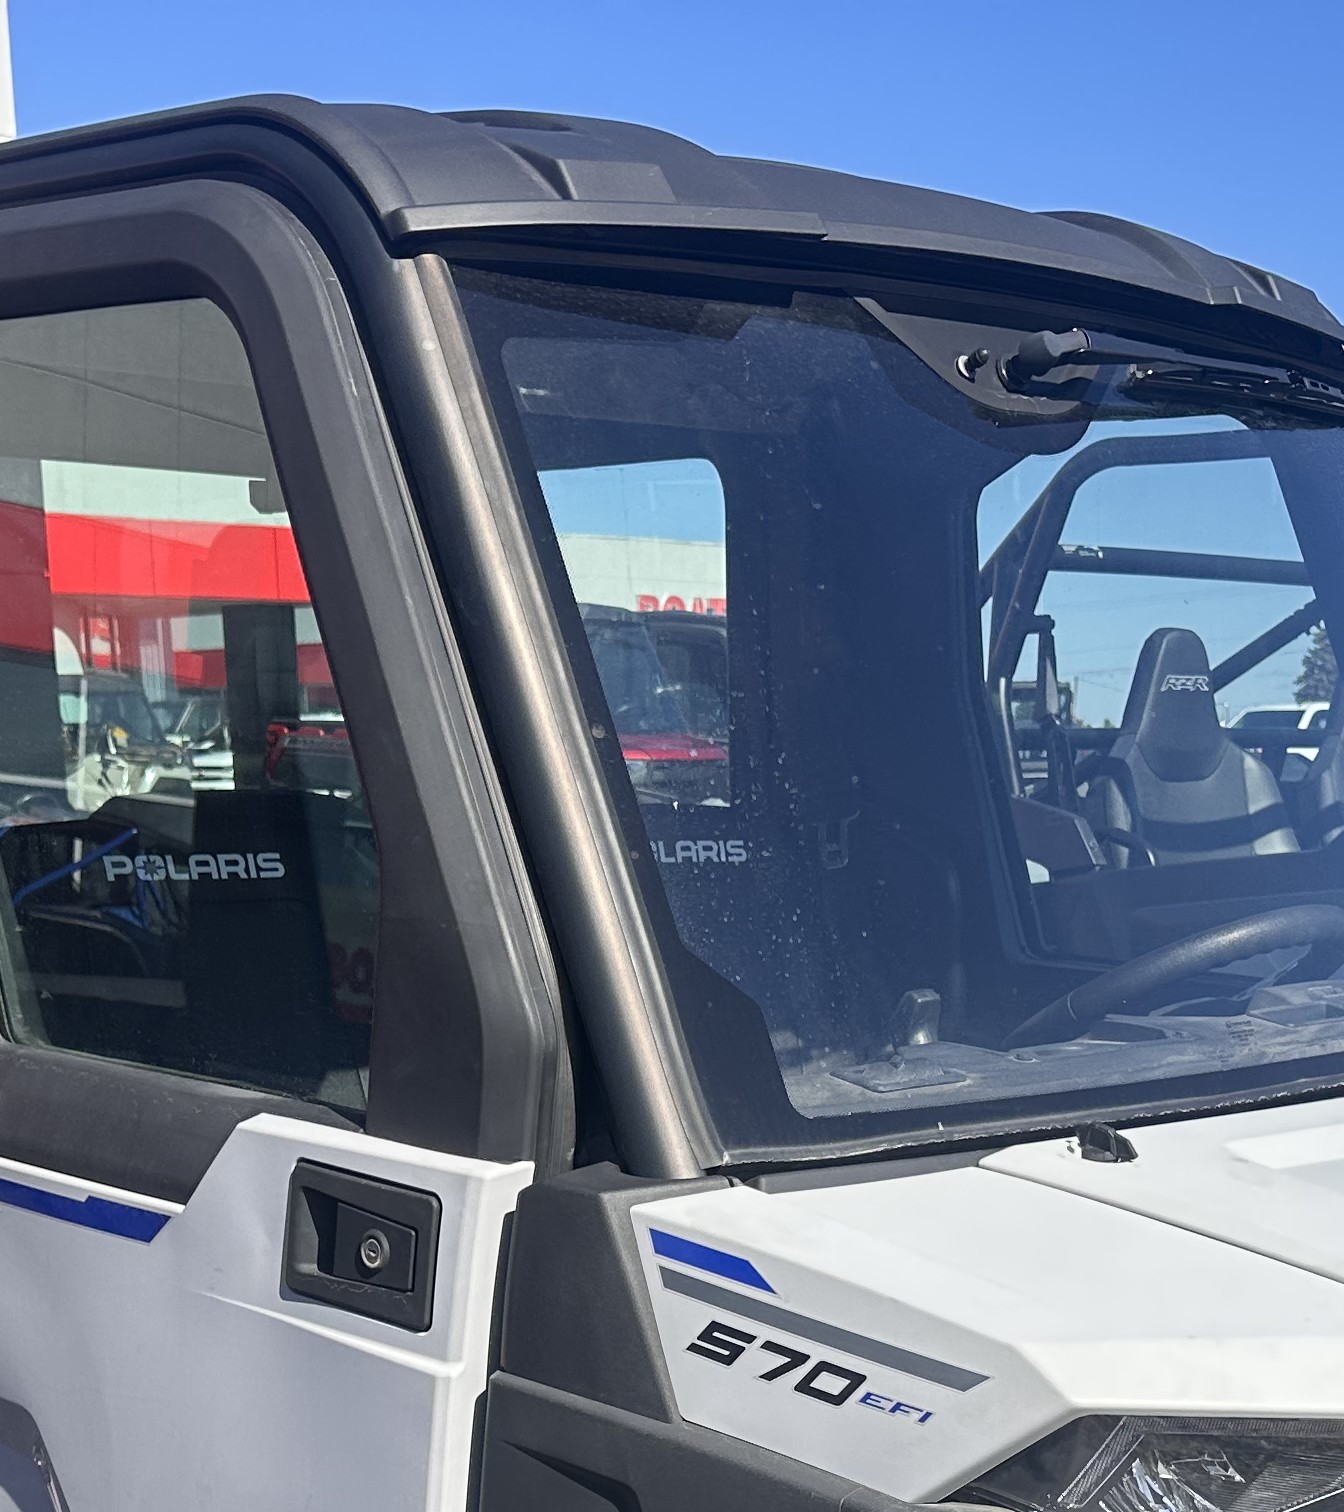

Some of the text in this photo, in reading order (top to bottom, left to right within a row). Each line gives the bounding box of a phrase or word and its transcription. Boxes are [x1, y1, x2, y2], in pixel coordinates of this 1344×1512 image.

[1160, 675, 1209, 692] RZR
[649, 840, 748, 864] LARIS
[102, 852, 286, 882] POLARIS
[685, 1320, 937, 1425] 570 EFI
